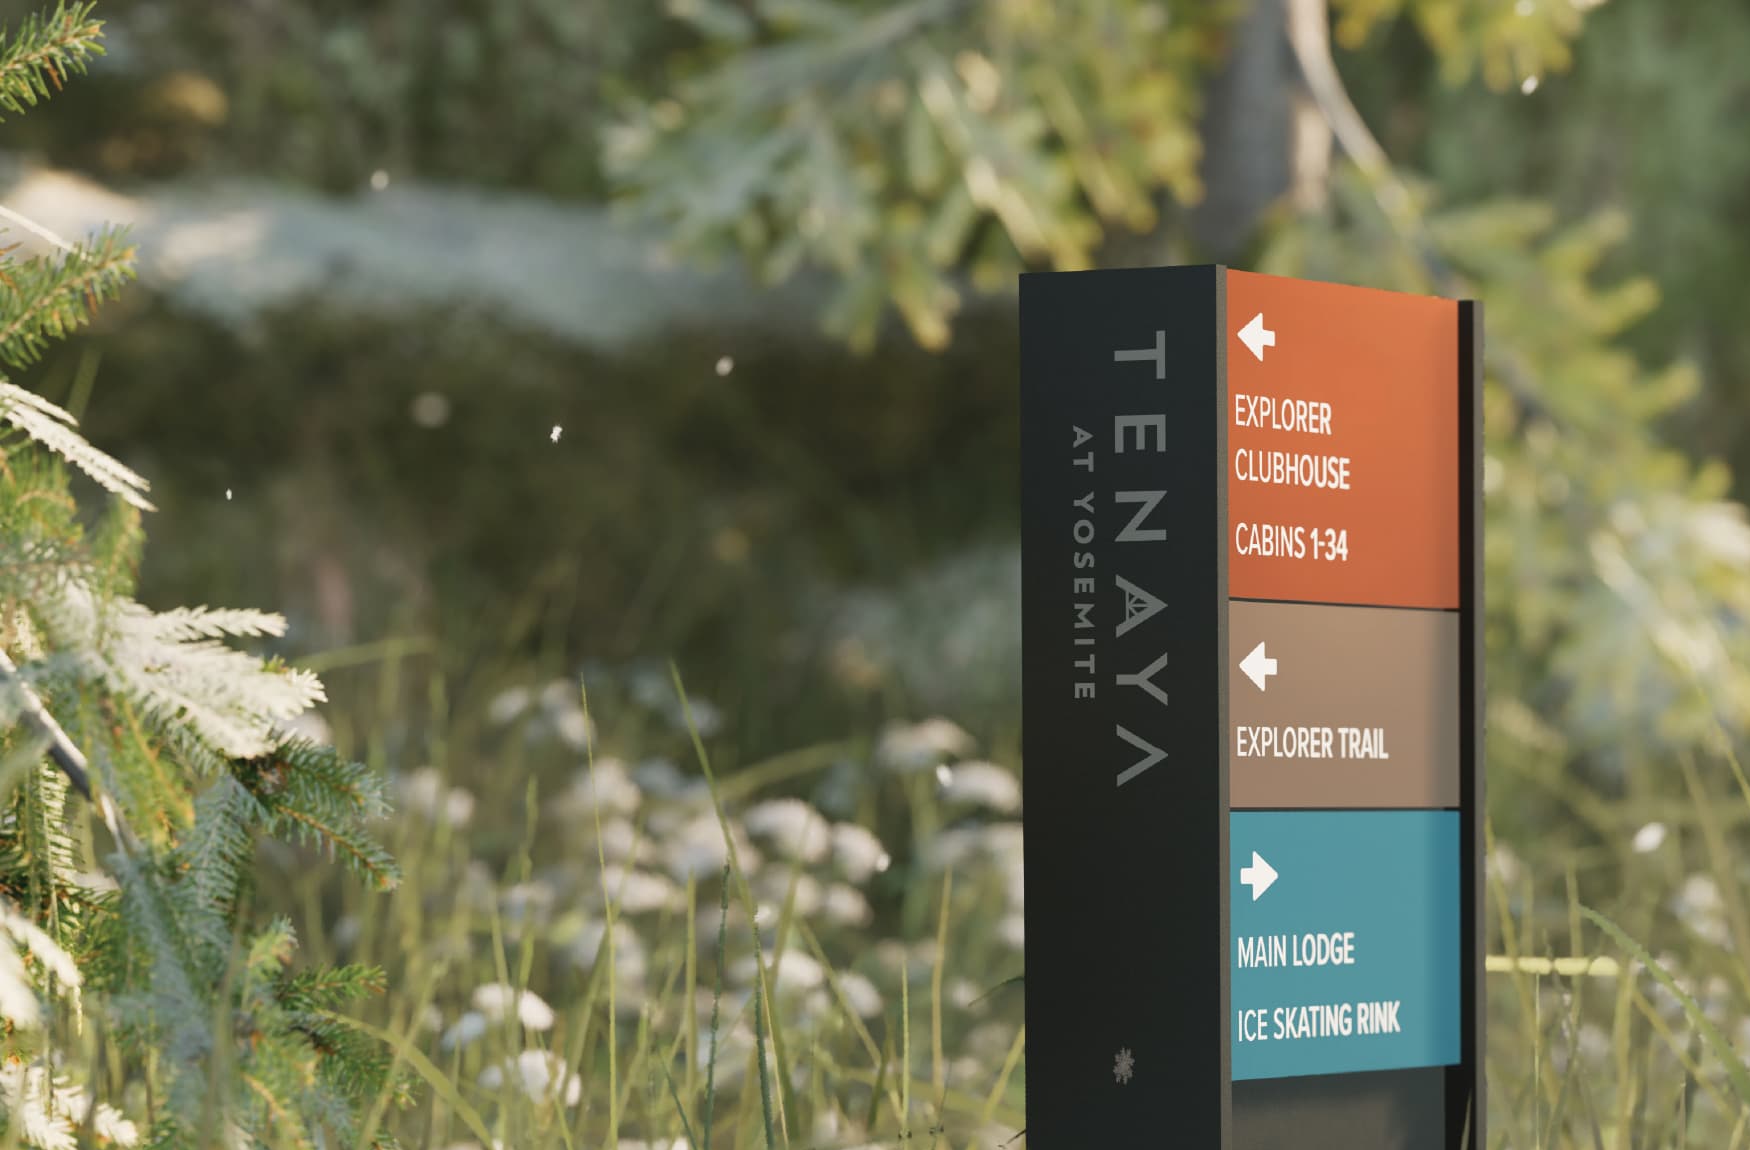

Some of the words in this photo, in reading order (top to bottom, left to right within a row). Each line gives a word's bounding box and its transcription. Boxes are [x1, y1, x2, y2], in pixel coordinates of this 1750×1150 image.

[1235, 394, 1332, 435] EXPLORER
[1073, 425, 1094, 472] AT
[1235, 448, 1351, 490] CLUBHOUSE
[1114, 330, 1168, 786] TENAYA
[1235, 523, 1305, 559] CABINS
[1310, 528, 1348, 561] 1-34
[1073, 491, 1095, 699] YOSEMITE
[1237, 727, 1333, 758] EXPLORER
[1338, 728, 1389, 759] TRAIL
[1238, 935, 1286, 968] MAIN
[1293, 932, 1354, 966] LODGE
[1238, 1009, 1268, 1041] ICE
[1274, 1003, 1352, 1039] SKATING
[1357, 1000, 1401, 1034] RINK
